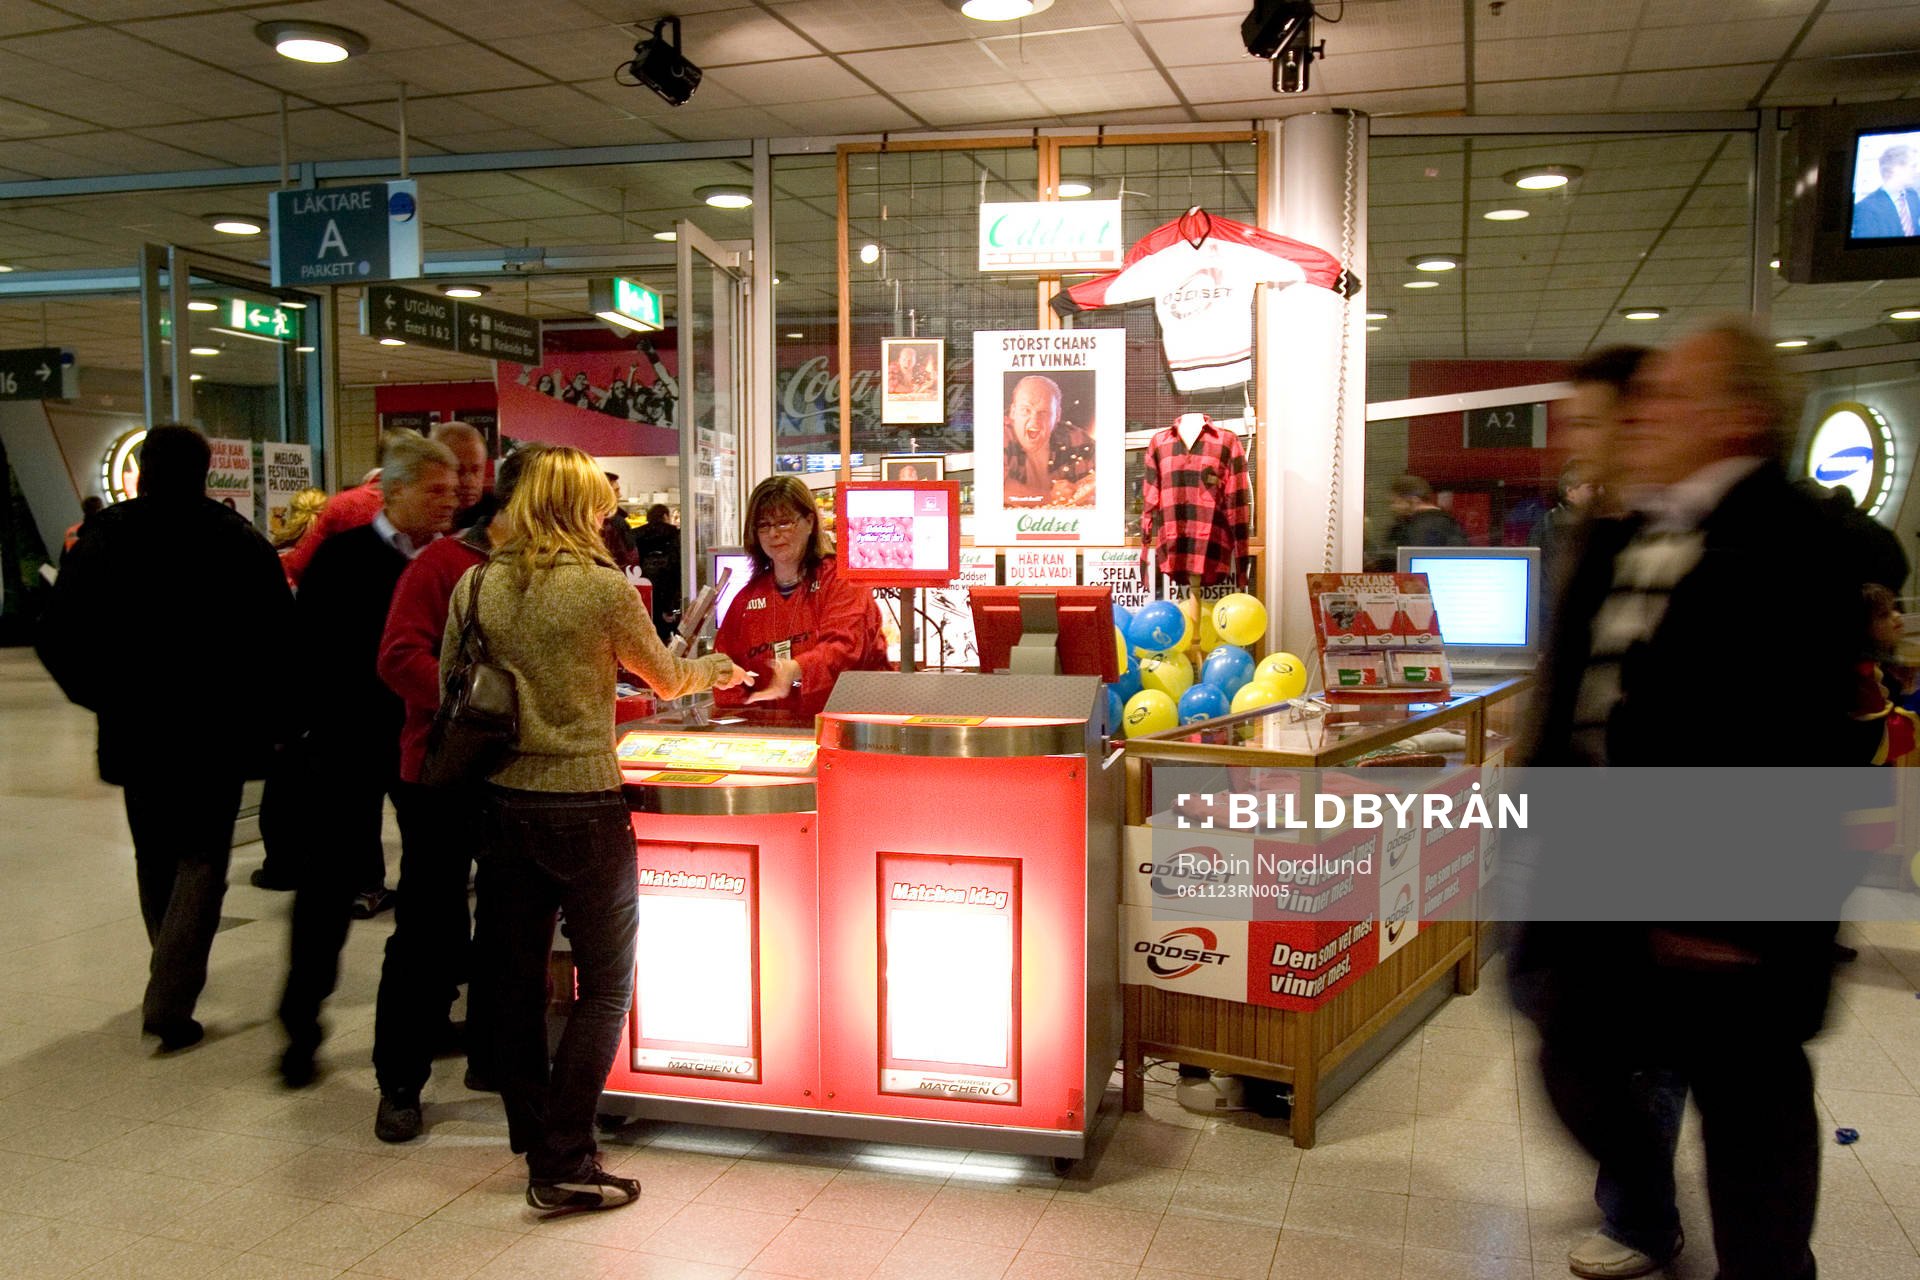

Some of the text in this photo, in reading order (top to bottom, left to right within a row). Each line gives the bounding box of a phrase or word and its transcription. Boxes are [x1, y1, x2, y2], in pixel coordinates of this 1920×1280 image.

[294, 191, 371, 215] LÄKTARE
[318, 219, 349, 259] A
[301, 262, 355, 278] PARKETT
[404, 299, 446, 319] UTGÅNG
[405, 319, 427, 336] Entré
[444, 327, 450, 341] 2
[1002, 335, 1097, 351] STÖRST CHANS
[1011, 353, 1086, 367] ATT VINNA!
[1486, 412, 1516, 429] A 2
[207, 471, 248, 489] Oddset
[268, 464, 309, 479] FESTIVALEN
[269, 478, 279, 490] PÅ
[1017, 513, 1080, 532] Oddset
[1019, 551, 1064, 566] HÄR KAN
[1102, 550, 1138, 562] Oddset
[959, 571, 987, 581] Oddset
[1011, 564, 1072, 579] DU SLÅ VAD!
[1341, 575, 1395, 586] VECKANS
[1387, 828, 1417, 853] ODDSET
[640, 869, 745, 895] Matchen Idag
[1138, 862, 1236, 884] ODDSET
[891, 883, 1008, 909] Matchen Idag
[1276, 888, 1331, 914] vinner
[1385, 901, 1414, 928] ODDSET
[1271, 912, 1373, 971] Den som vet mest
[1134, 941, 1230, 966] ODDSET
[1271, 953, 1351, 998] vinner mest.
[668, 1061, 732, 1073] MATCHEN
[919, 1082, 990, 1094] MATCHEN
